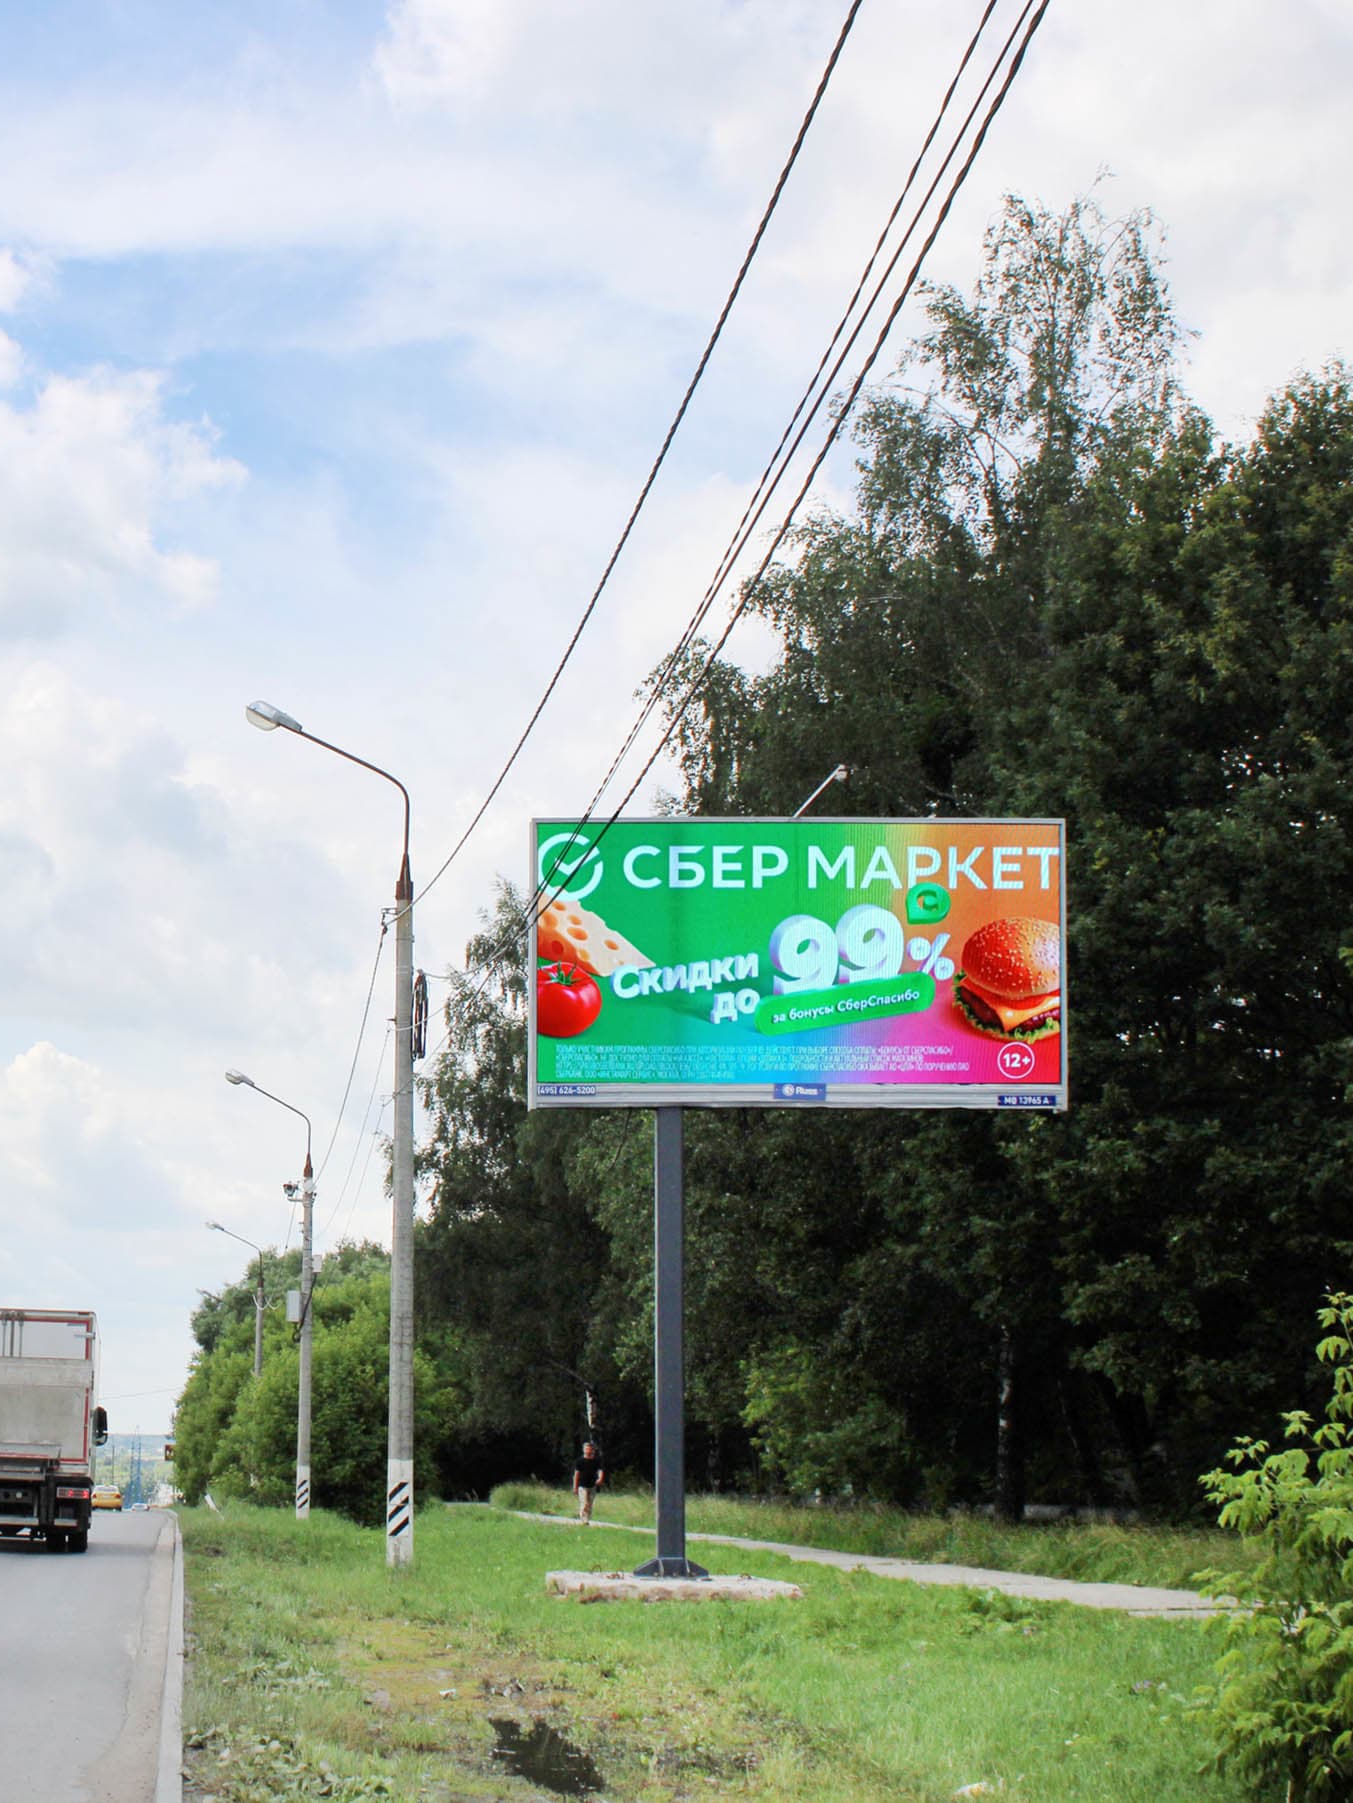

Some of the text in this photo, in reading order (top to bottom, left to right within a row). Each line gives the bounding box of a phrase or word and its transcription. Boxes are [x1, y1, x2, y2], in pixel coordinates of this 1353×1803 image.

[623, 845, 1060, 890] СБЕР МАРКЕТ
[610, 952, 760, 999] Скидки
[710, 988, 760, 1024] до
[772, 988, 920, 1024] за бонусы СберСпасибо
[1003, 1053, 1031, 1068] 12+
